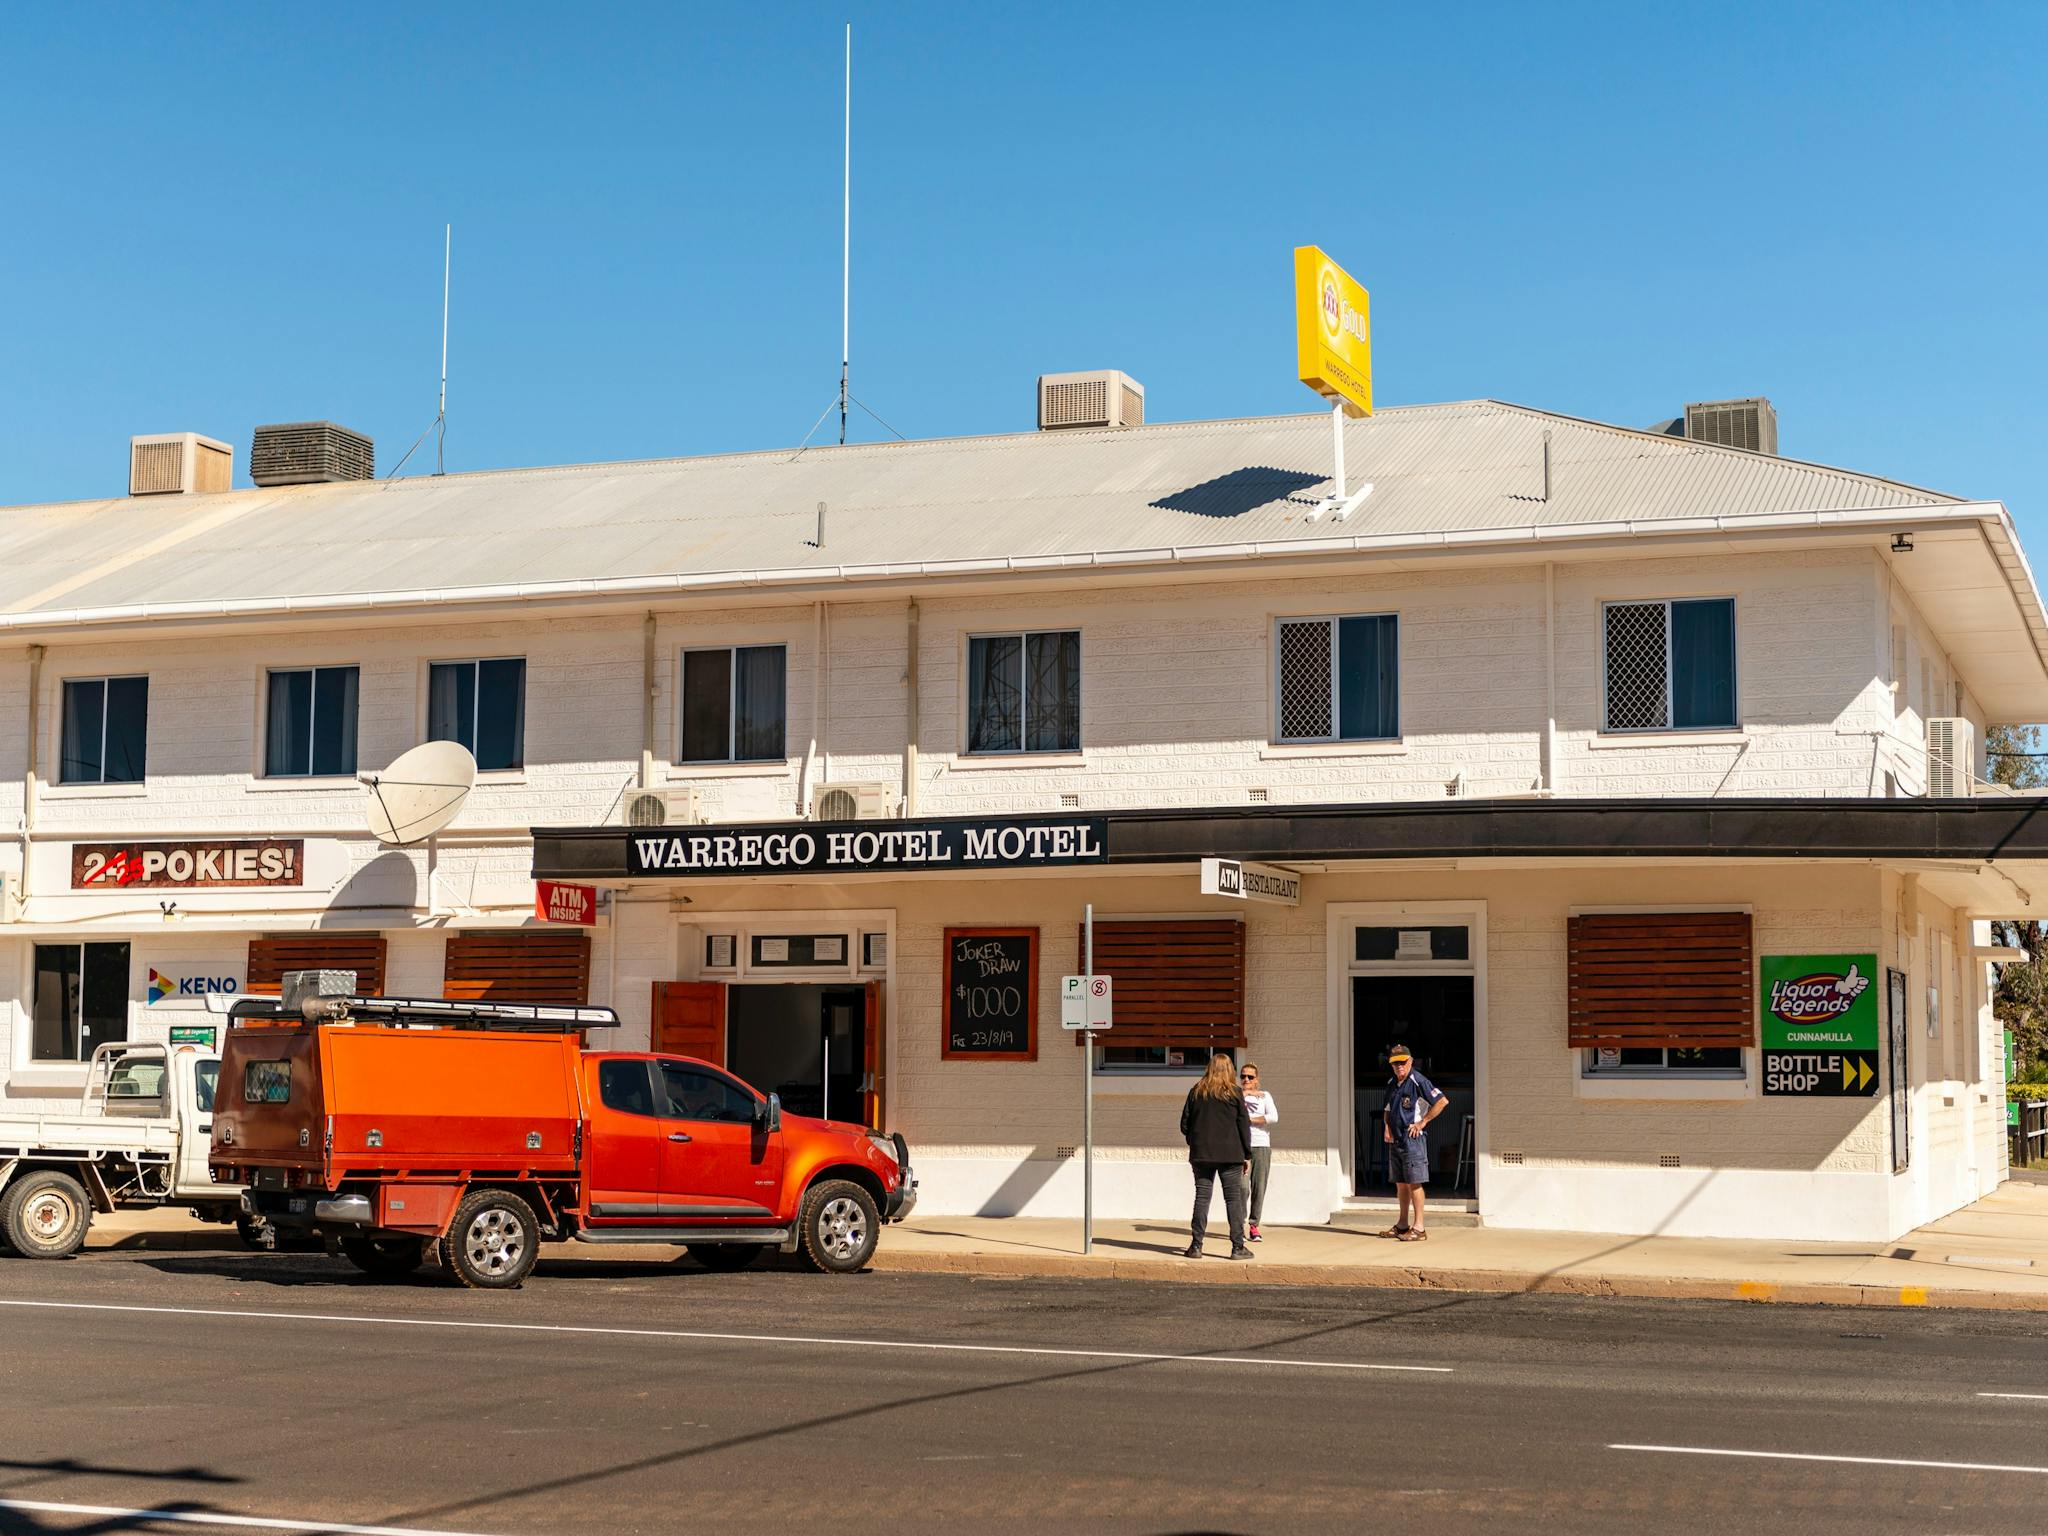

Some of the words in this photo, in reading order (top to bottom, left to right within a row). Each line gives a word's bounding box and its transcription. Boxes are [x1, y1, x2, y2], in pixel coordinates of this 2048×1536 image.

[1342, 299, 1366, 342] GOLD
[1325, 359, 1350, 386] WARREGO
[1351, 378, 1367, 400] HOTEL
[635, 834, 816, 868] WARREGO
[826, 830, 951, 864] HOTEL
[963, 825, 1100, 860] MOTEL
[142, 847, 294, 881] POKIES!
[1220, 868, 1238, 889] ATM
[1242, 872, 1298, 898] RESTAURANT
[550, 886, 582, 908] ATM
[549, 906, 581, 921] INSIDE
[957, 939, 1005, 962] JOKER
[978, 958, 1020, 977] DRAW
[180, 977, 237, 994] KENO
[1069, 979, 1078, 991] P
[1771, 980, 1832, 1000] Liquor
[956, 983, 1021, 1018] $1000
[1770, 996, 1850, 1016] Legends
[972, 1029, 1013, 1047] 23/8/19
[1787, 1032, 1853, 1042] CUNNAMULLA
[1767, 1054, 1840, 1073] BOTTLE
[1766, 1073, 1820, 1091] SHOP
